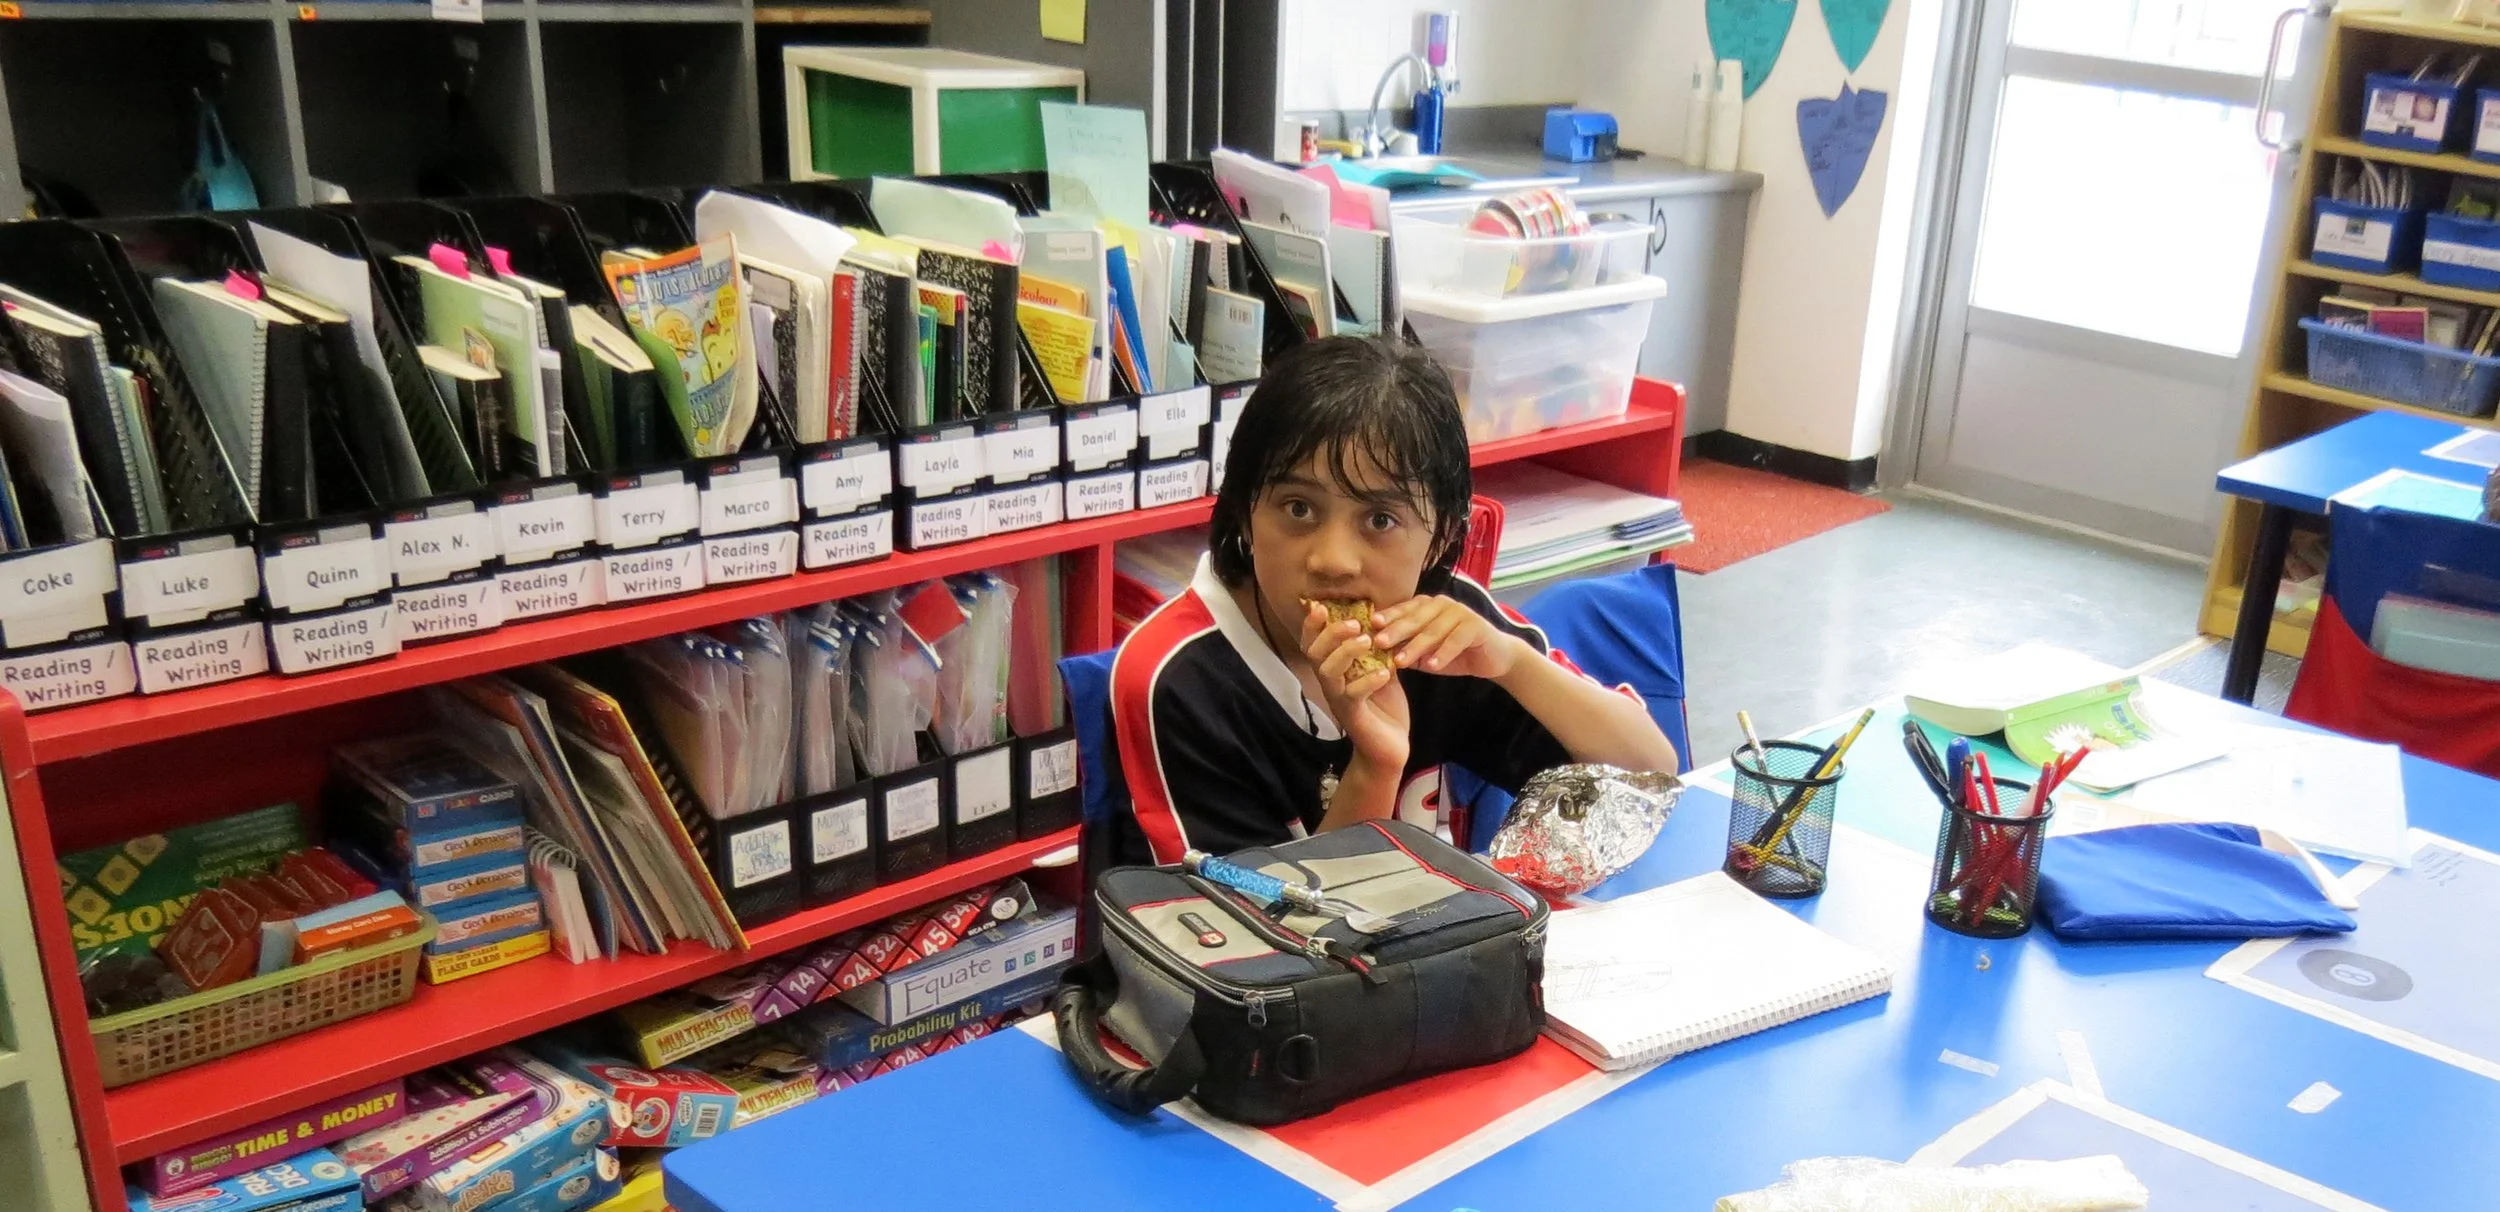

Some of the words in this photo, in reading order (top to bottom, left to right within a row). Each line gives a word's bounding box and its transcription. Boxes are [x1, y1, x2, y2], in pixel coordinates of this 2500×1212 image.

[1017, 286, 1058, 306] iculous
[1166, 410, 1186, 421] Ella
[1082, 430, 1117, 447] Daniel
[1013, 448, 1034, 460] Mia
[924, 458, 959, 473] Layla
[835, 474, 863, 490] Amy
[1146, 468, 1188, 486] Reading
[1079, 480, 1123, 497] Reading
[1154, 485, 1192, 502] Writing
[724, 500, 770, 517] Marco
[989, 494, 1037, 512] Reading
[1084, 497, 1124, 513] Writing
[622, 509, 665, 528] Terry
[916, 507, 962, 523] eading
[998, 510, 1043, 527] Writing
[518, 518, 565, 537] Kevin
[814, 521, 868, 541] Reading
[921, 523, 968, 540] Writing
[401, 538, 441, 557] Alex
[452, 534, 470, 549] N.
[710, 539, 769, 559] Reading
[825, 541, 875, 560] Writing
[610, 555, 673, 577] Reading
[722, 560, 777, 578] Writing
[22, 570, 75, 596] Coke
[161, 575, 210, 596] Luke
[306, 566, 359, 588] Quinn
[501, 572, 568, 595] Reading
[623, 576, 681, 595] Writing
[396, 591, 467, 613] Reading
[516, 591, 578, 613] Writing
[292, 617, 369, 644] Reading
[413, 612, 478, 633] Writing
[145, 636, 229, 664] Reading
[304, 639, 375, 665] Writing
[4, 655, 93, 684] Reading
[166, 657, 243, 684] Writing
[24, 678, 107, 705] Writing
[943, 902, 971, 928] 54
[867, 935, 896, 962] 32
[922, 927, 948, 957] 45
[789, 971, 816, 995] 14
[843, 963, 872, 987] 24
[905, 958, 992, 1017] Equate
[764, 1003, 781, 1018] 7
[870, 1012, 956, 1053] Probability
[960, 1003, 982, 1022] Kit
[235, 1130, 288, 1158] TIME
[296, 1121, 314, 1139] &
[322, 1093, 397, 1131] MONEY
[429, 1137, 468, 1160] Addition
[469, 1131, 477, 1141] &
[478, 1104, 529, 1135] Subtraction
